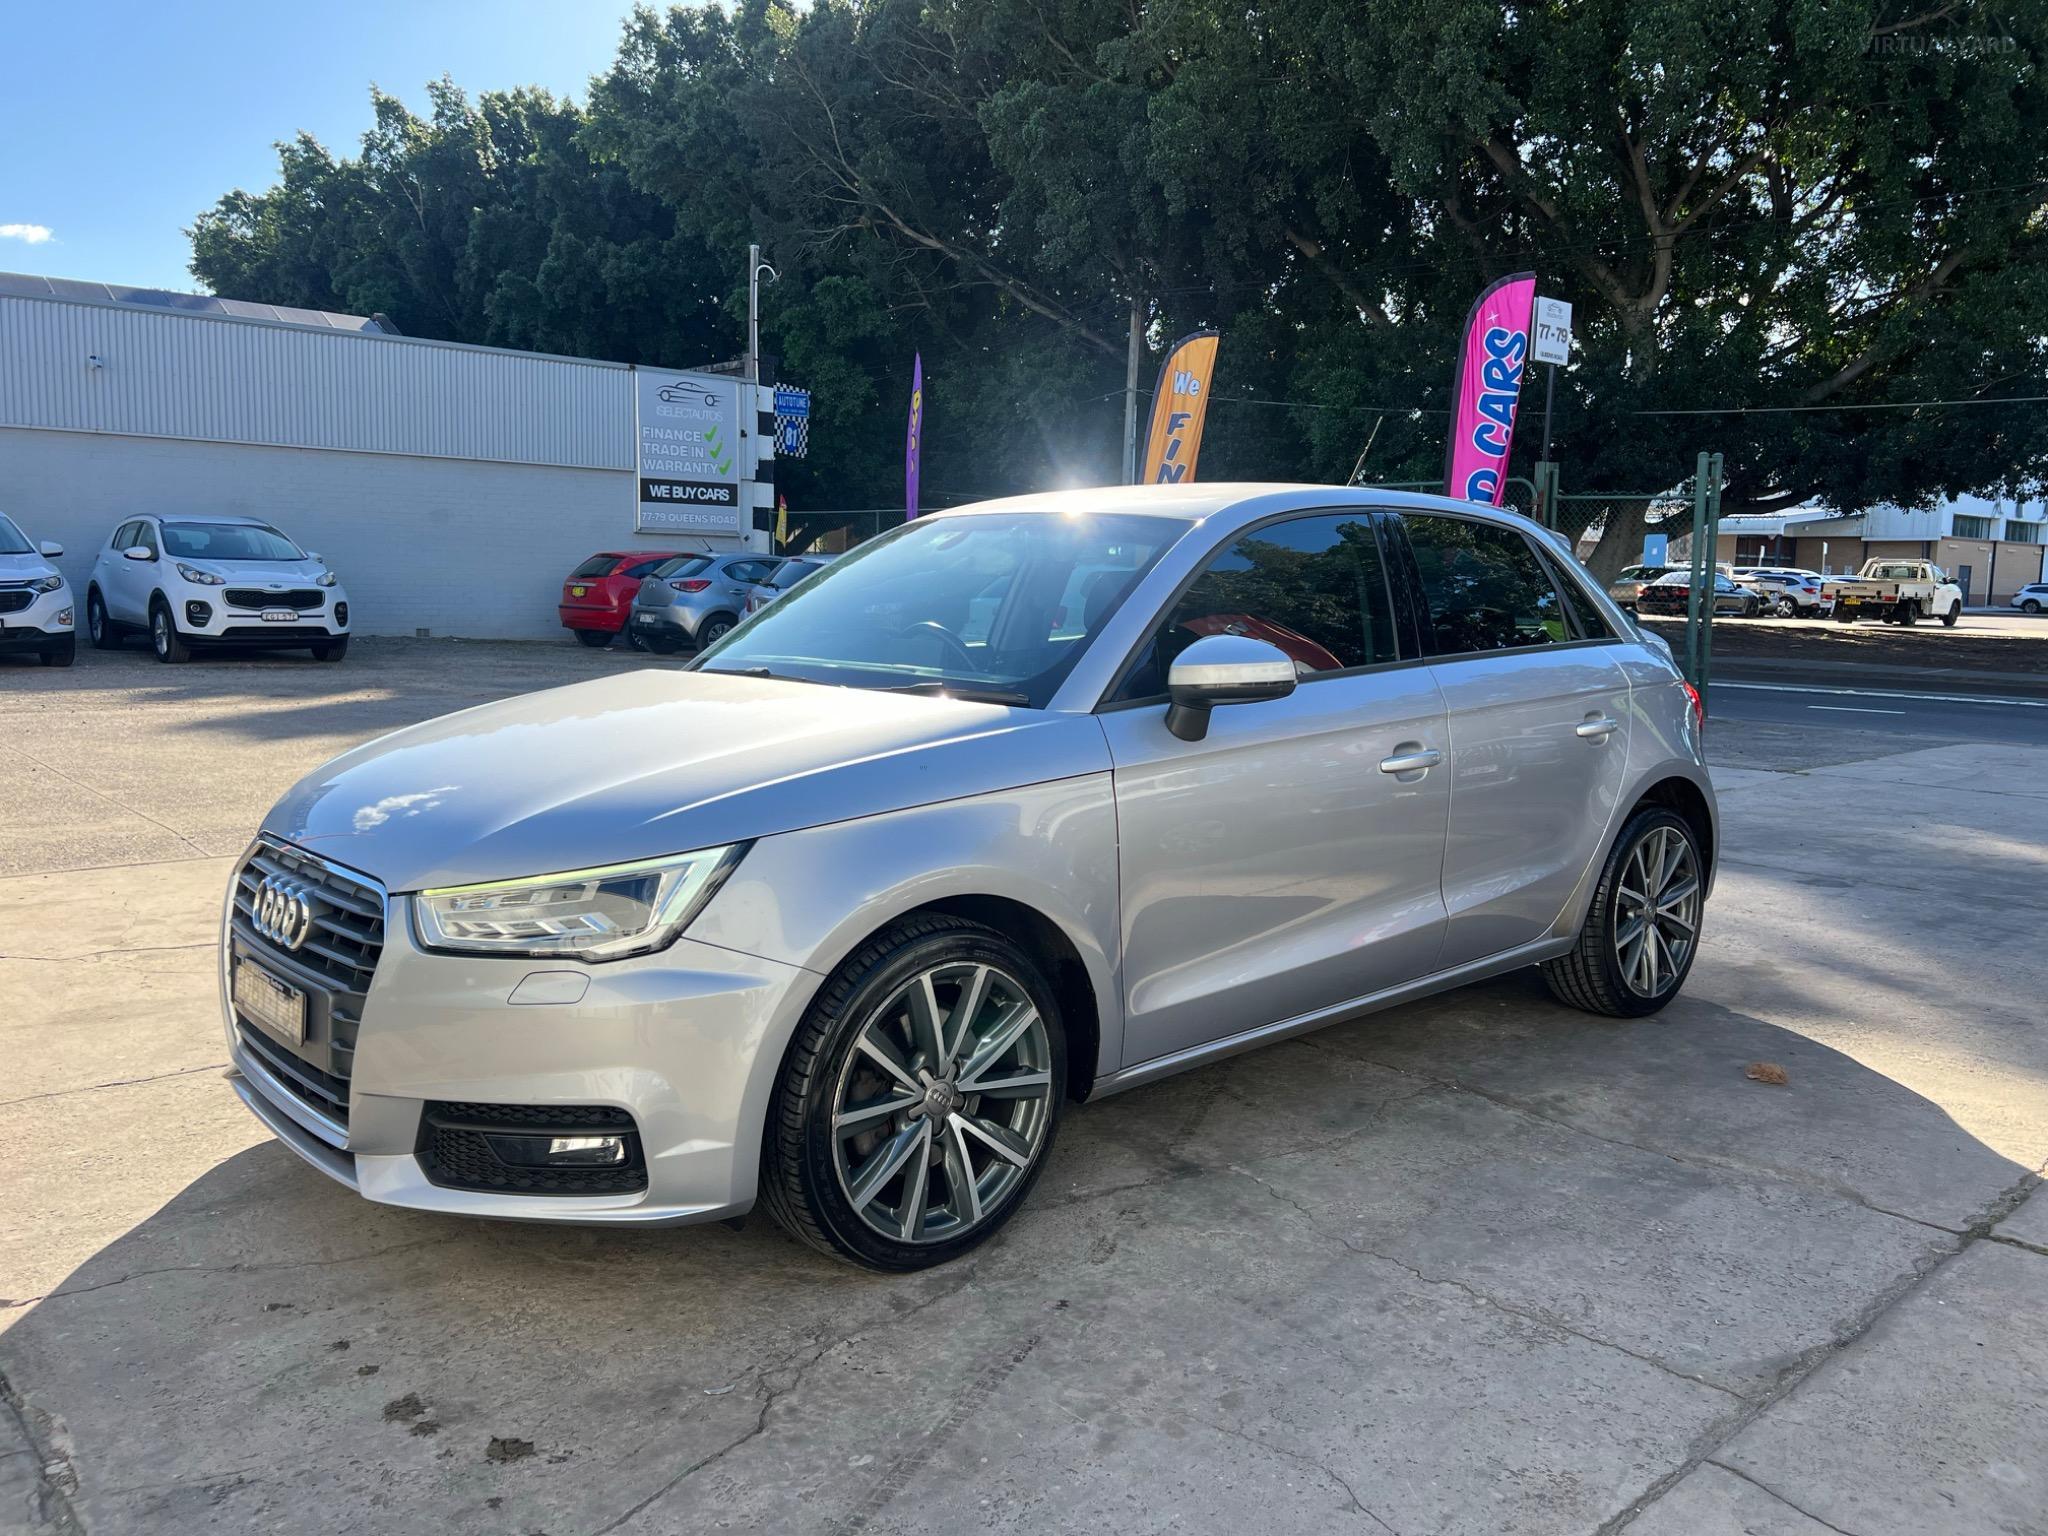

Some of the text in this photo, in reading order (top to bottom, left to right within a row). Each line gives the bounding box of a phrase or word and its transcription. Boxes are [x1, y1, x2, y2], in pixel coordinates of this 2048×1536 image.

[1173, 370, 1201, 396] We
[1472, 326, 1527, 458] CARS
[642, 427, 701, 442] FINANCE
[643, 443, 704, 458] TRADE IN
[643, 459, 718, 474] WARRANTY
[649, 485, 730, 501] WE BUY CARS
[642, 512, 737, 525] 77-79 QUEENS ROAD
